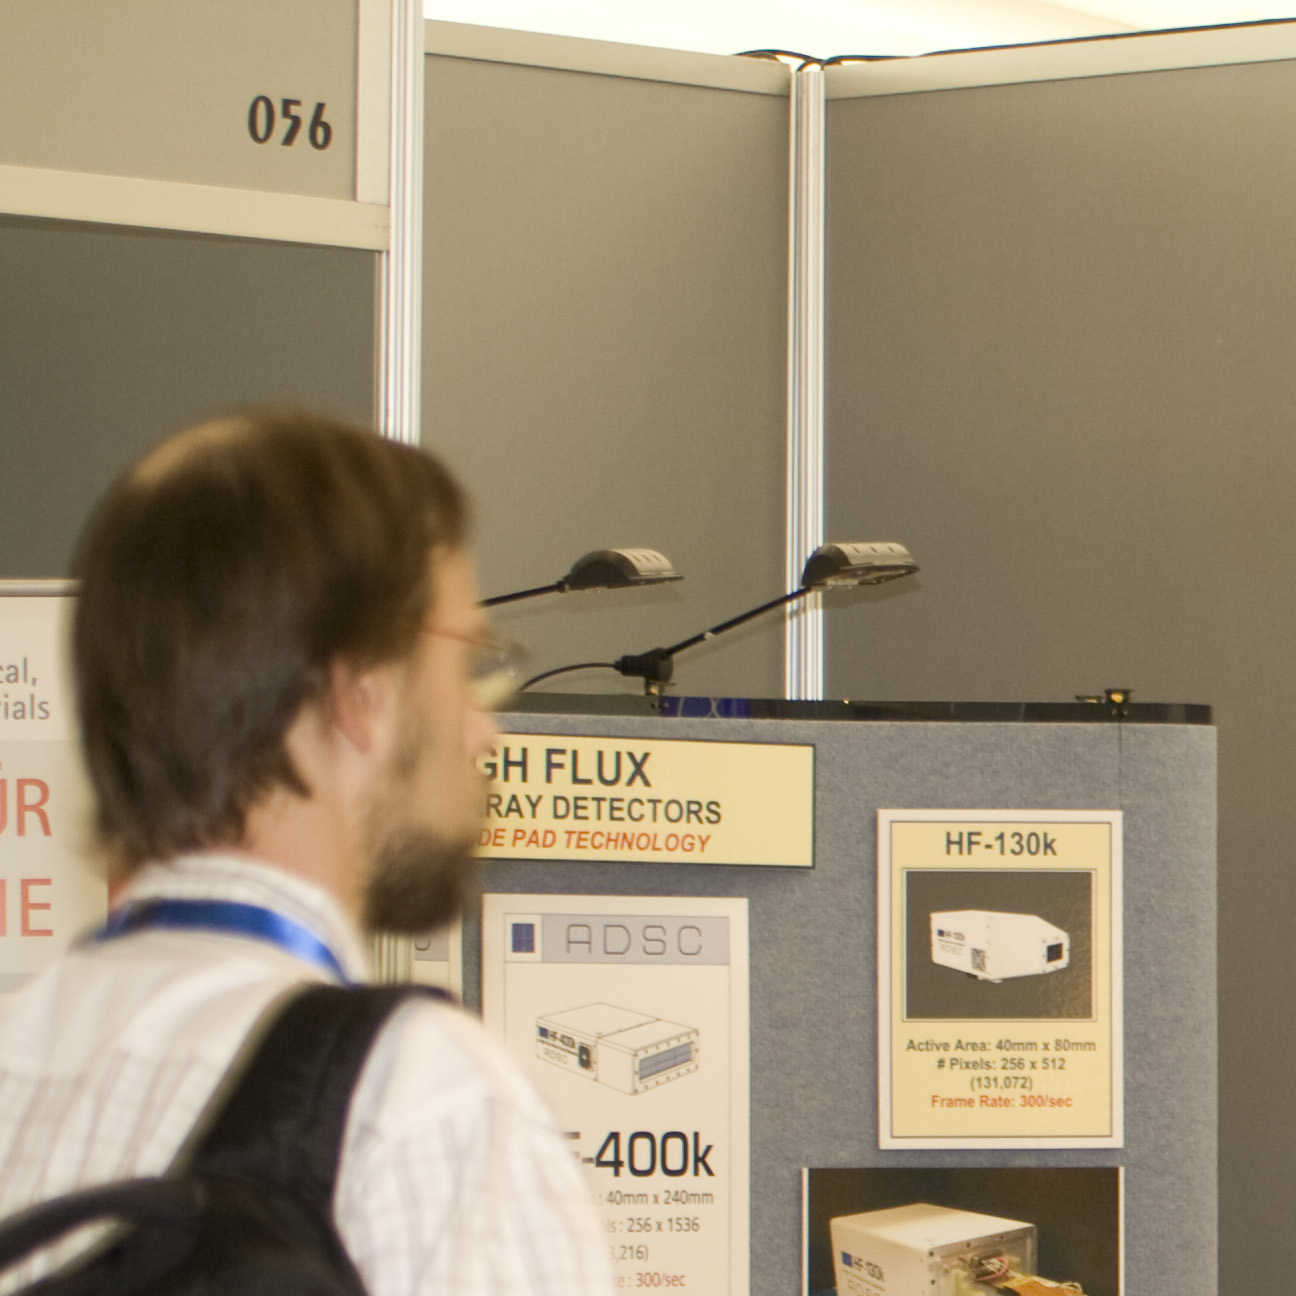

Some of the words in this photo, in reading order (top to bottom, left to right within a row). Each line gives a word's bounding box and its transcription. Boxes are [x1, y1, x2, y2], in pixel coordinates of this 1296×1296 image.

[247, 94, 334, 151] 056
[545, 747, 653, 788] FLUX
[552, 794, 723, 825] DETECTORS
[511, 828, 557, 850] PAD
[564, 829, 712, 853] TECHNOLOGY
[945, 831, 1059, 857] HF-130k
[565, 923, 705, 957] ADSC
[906, 1039, 950, 1052] Active
[955, 1039, 992, 1052] Area:
[995, 1039, 1038, 1052] 40mm
[1042, 1042, 1050, 1052] x
[949, 1057, 997, 1071] Pixels:
[1001, 1057, 1026, 1071] 256
[1029, 1061, 1038, 1071] x
[1041, 1058, 1067, 1071] 512
[931, 1094, 976, 1109] Frame
[979, 1094, 1017, 1108] Rate:
[565, 1130, 715, 1178] -400k
[606, 1190, 649, 1206] 40mm
[652, 1193, 660, 1205] x
[663, 1190, 715, 1205] 240mm
[626, 1217, 653, 1233] 256
[655, 1221, 664, 1232] x
[667, 1217, 701, 1232] 1536
